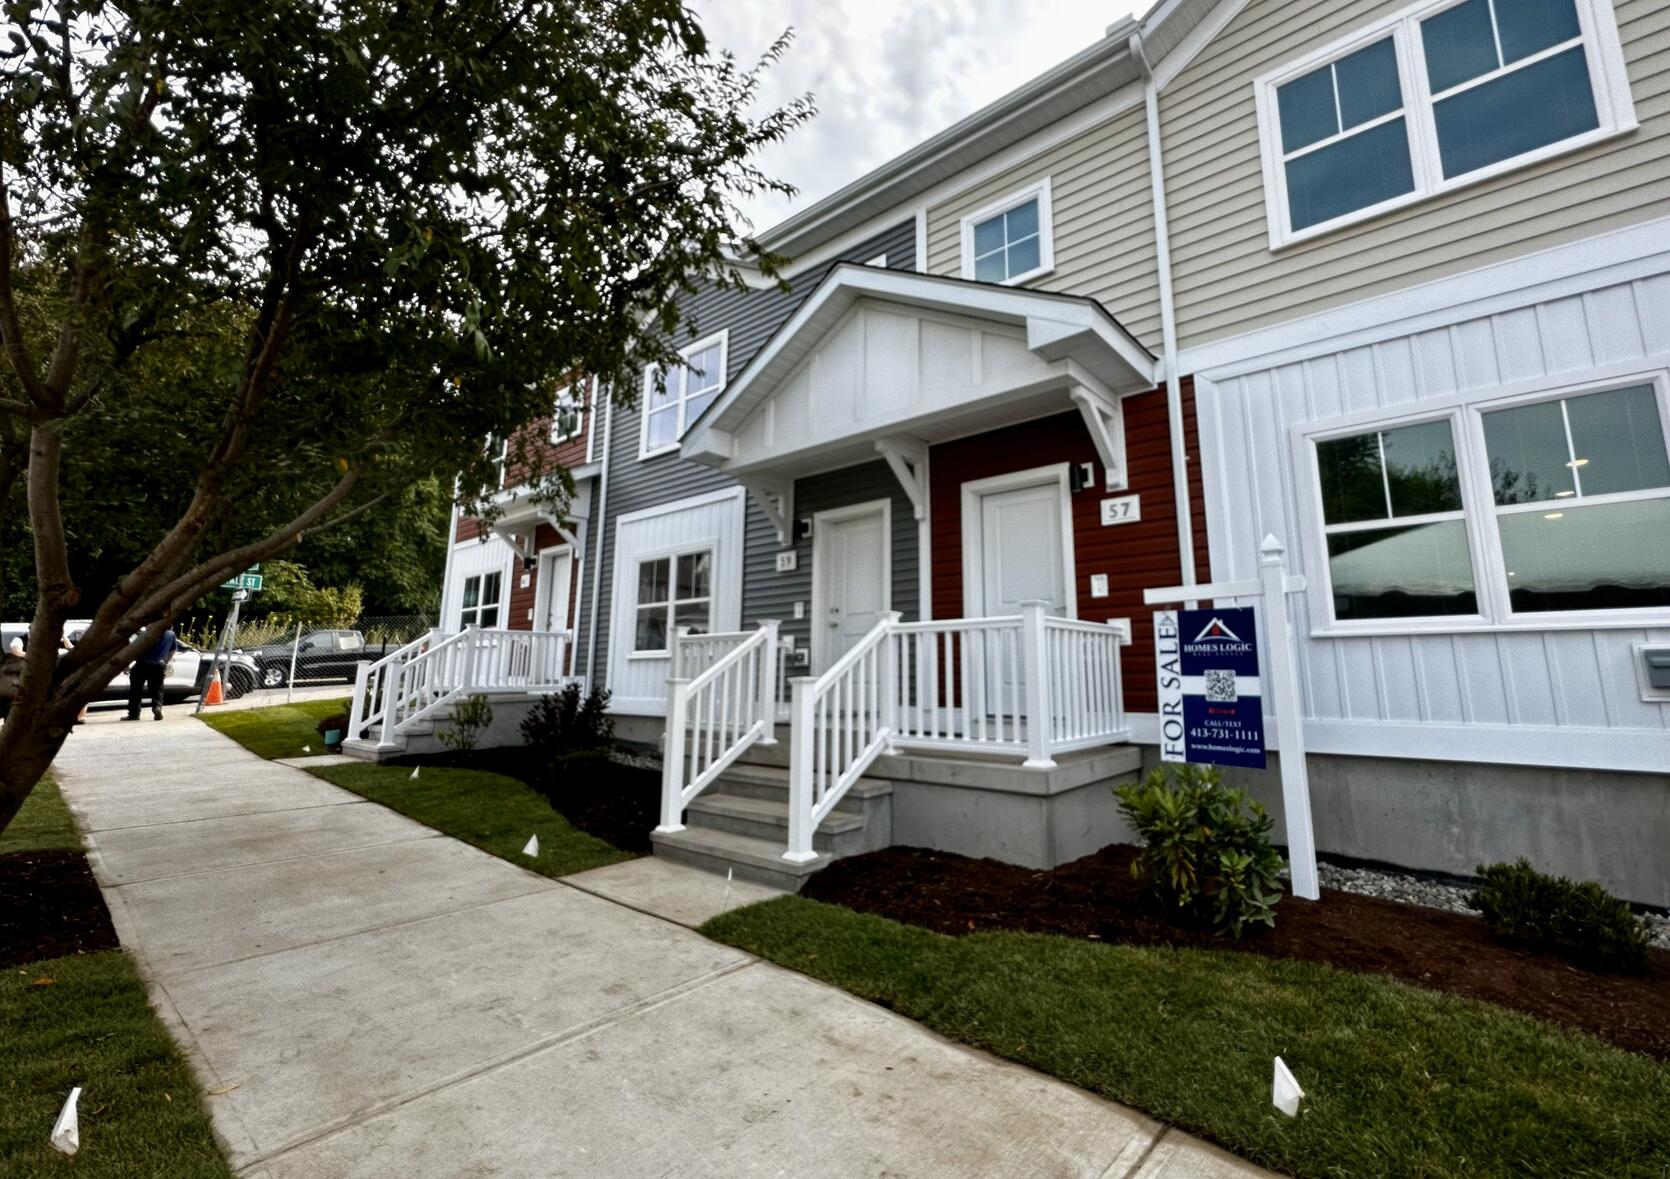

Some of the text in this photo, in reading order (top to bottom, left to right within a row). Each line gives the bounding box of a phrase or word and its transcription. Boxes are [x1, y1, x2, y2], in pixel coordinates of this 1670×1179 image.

[1109, 501, 1131, 518] 57
[246, 577, 256, 587] ST
[1184, 641, 1253, 653] HOMES LOGIC
[1159, 626, 1185, 757] FOR SALE
[1204, 719, 1242, 728] CALL/TEXT
[1190, 728, 1259, 741] 413-731-1111
